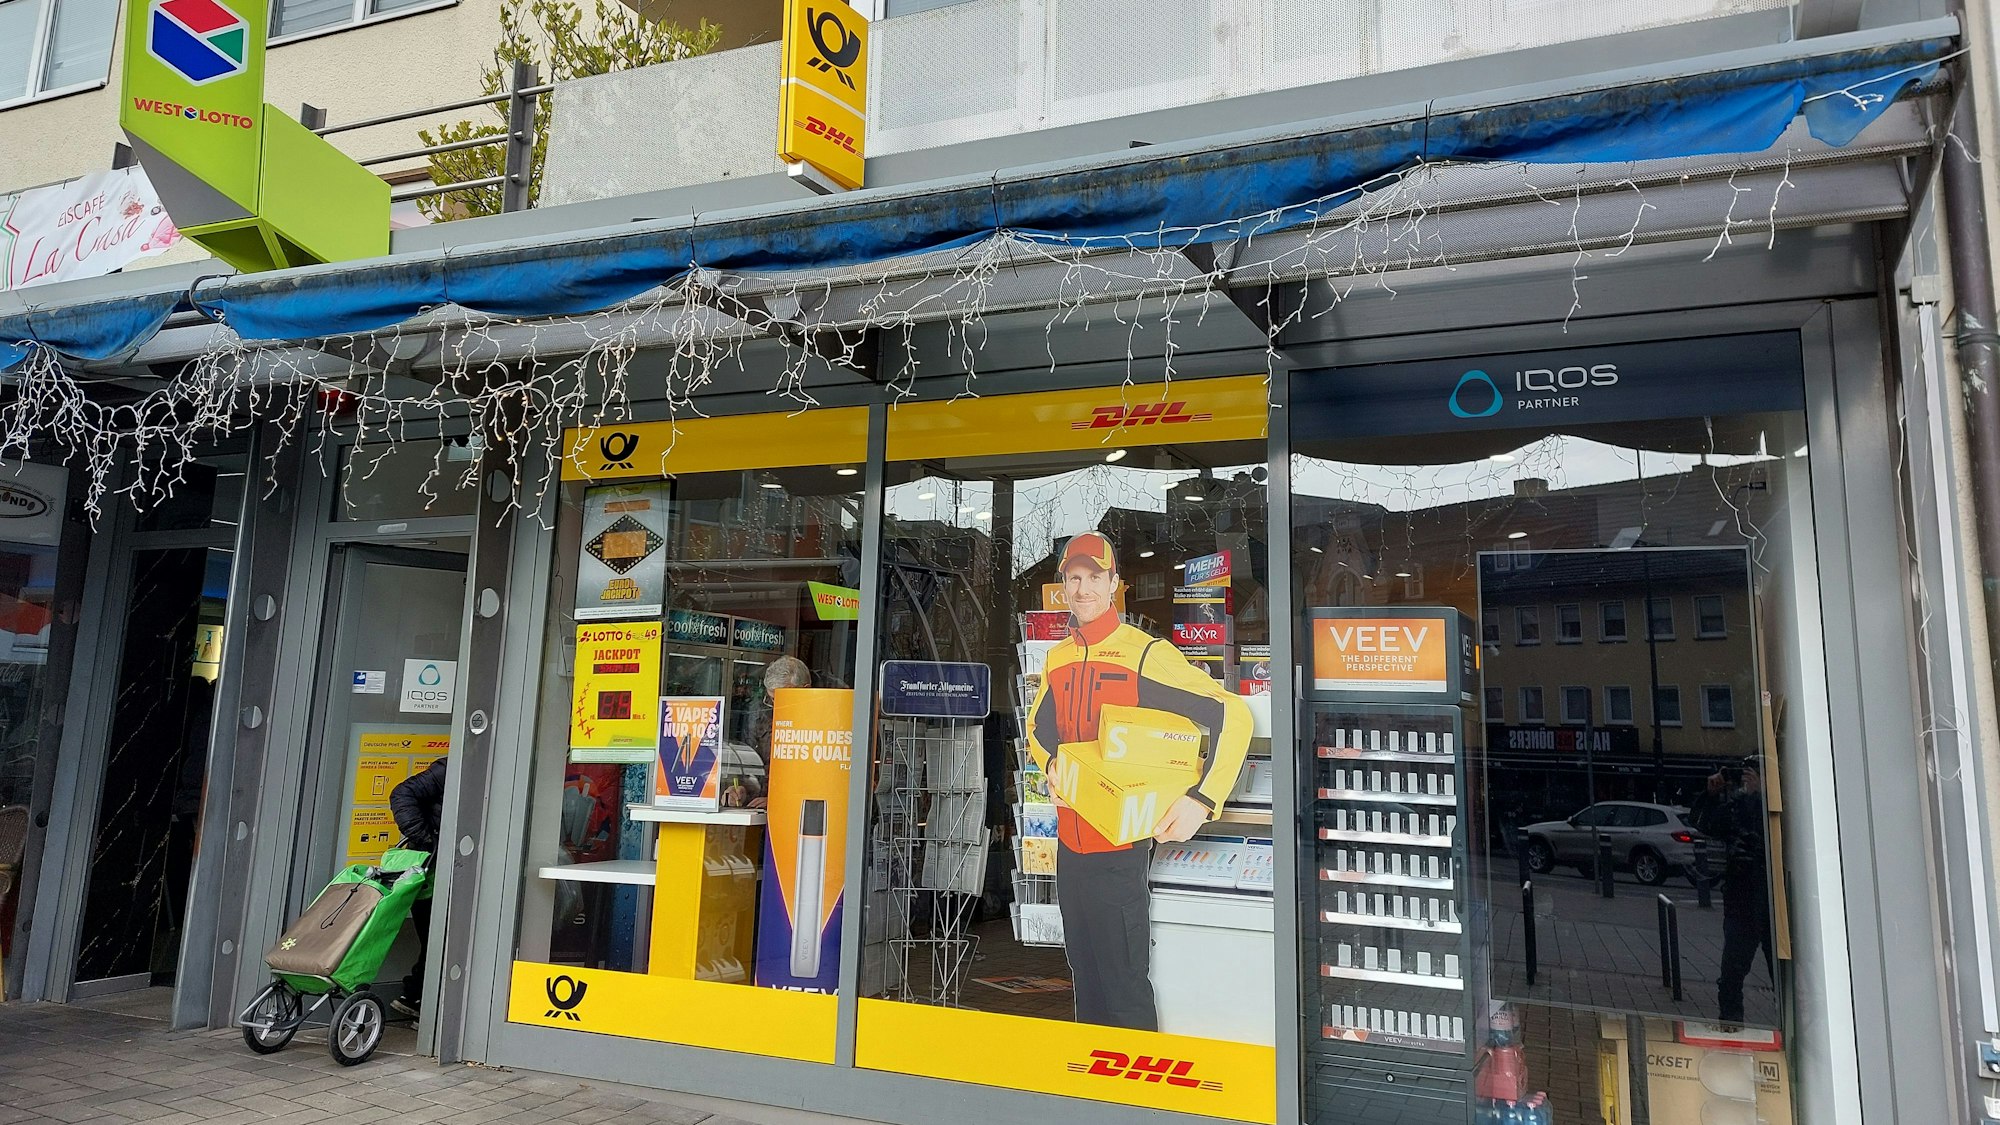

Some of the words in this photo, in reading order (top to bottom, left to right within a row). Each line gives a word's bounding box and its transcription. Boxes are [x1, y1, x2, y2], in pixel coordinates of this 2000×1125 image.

[805, 116, 858, 153] DHL
[58, 190, 105, 227] EISCAFÉ
[20, 236, 65, 285] La
[75, 215, 145, 262] Casa
[1515, 363, 1619, 393] IQOS
[1517, 396, 1580, 411] PARTNER
[1090, 401, 1193, 429] DHL
[1188, 555, 1225, 574] MEHR
[1210, 566, 1229, 579] GELD!
[600, 588, 640, 600] JACKPOT
[817, 593, 837, 606] WEST
[592, 631, 623, 642] LOTTO
[1180, 626, 1218, 641] ELIXYR
[1329, 627, 1428, 652] VEEV
[593, 648, 641, 660] JACKPOT
[1340, 655, 1361, 663] THE
[1363, 655, 1418, 664] DIFFERENT
[1346, 663, 1414, 672] PERSPECTIVE
[900, 679, 938, 692] Frankfurter
[938, 681, 974, 693] Allgemeine
[407, 690, 448, 702] IQOS
[664, 706, 674, 722] 2
[676, 706, 718, 724] VAPES
[663, 722, 689, 738] NUR
[775, 720, 793, 728] WHERE
[774, 729, 824, 744] PREMIUM
[1106, 725, 1129, 759] S
[1163, 731, 1197, 743] PACKSET
[773, 743, 810, 760] MEETS
[1169, 759, 1189, 767] DHL
[675, 776, 698, 785] VEEV
[1119, 791, 1158, 842] M
[1384, 1036, 1402, 1044] VEEV
[1088, 1049, 1201, 1089] DHL
[1763, 1065, 1776, 1078] M
